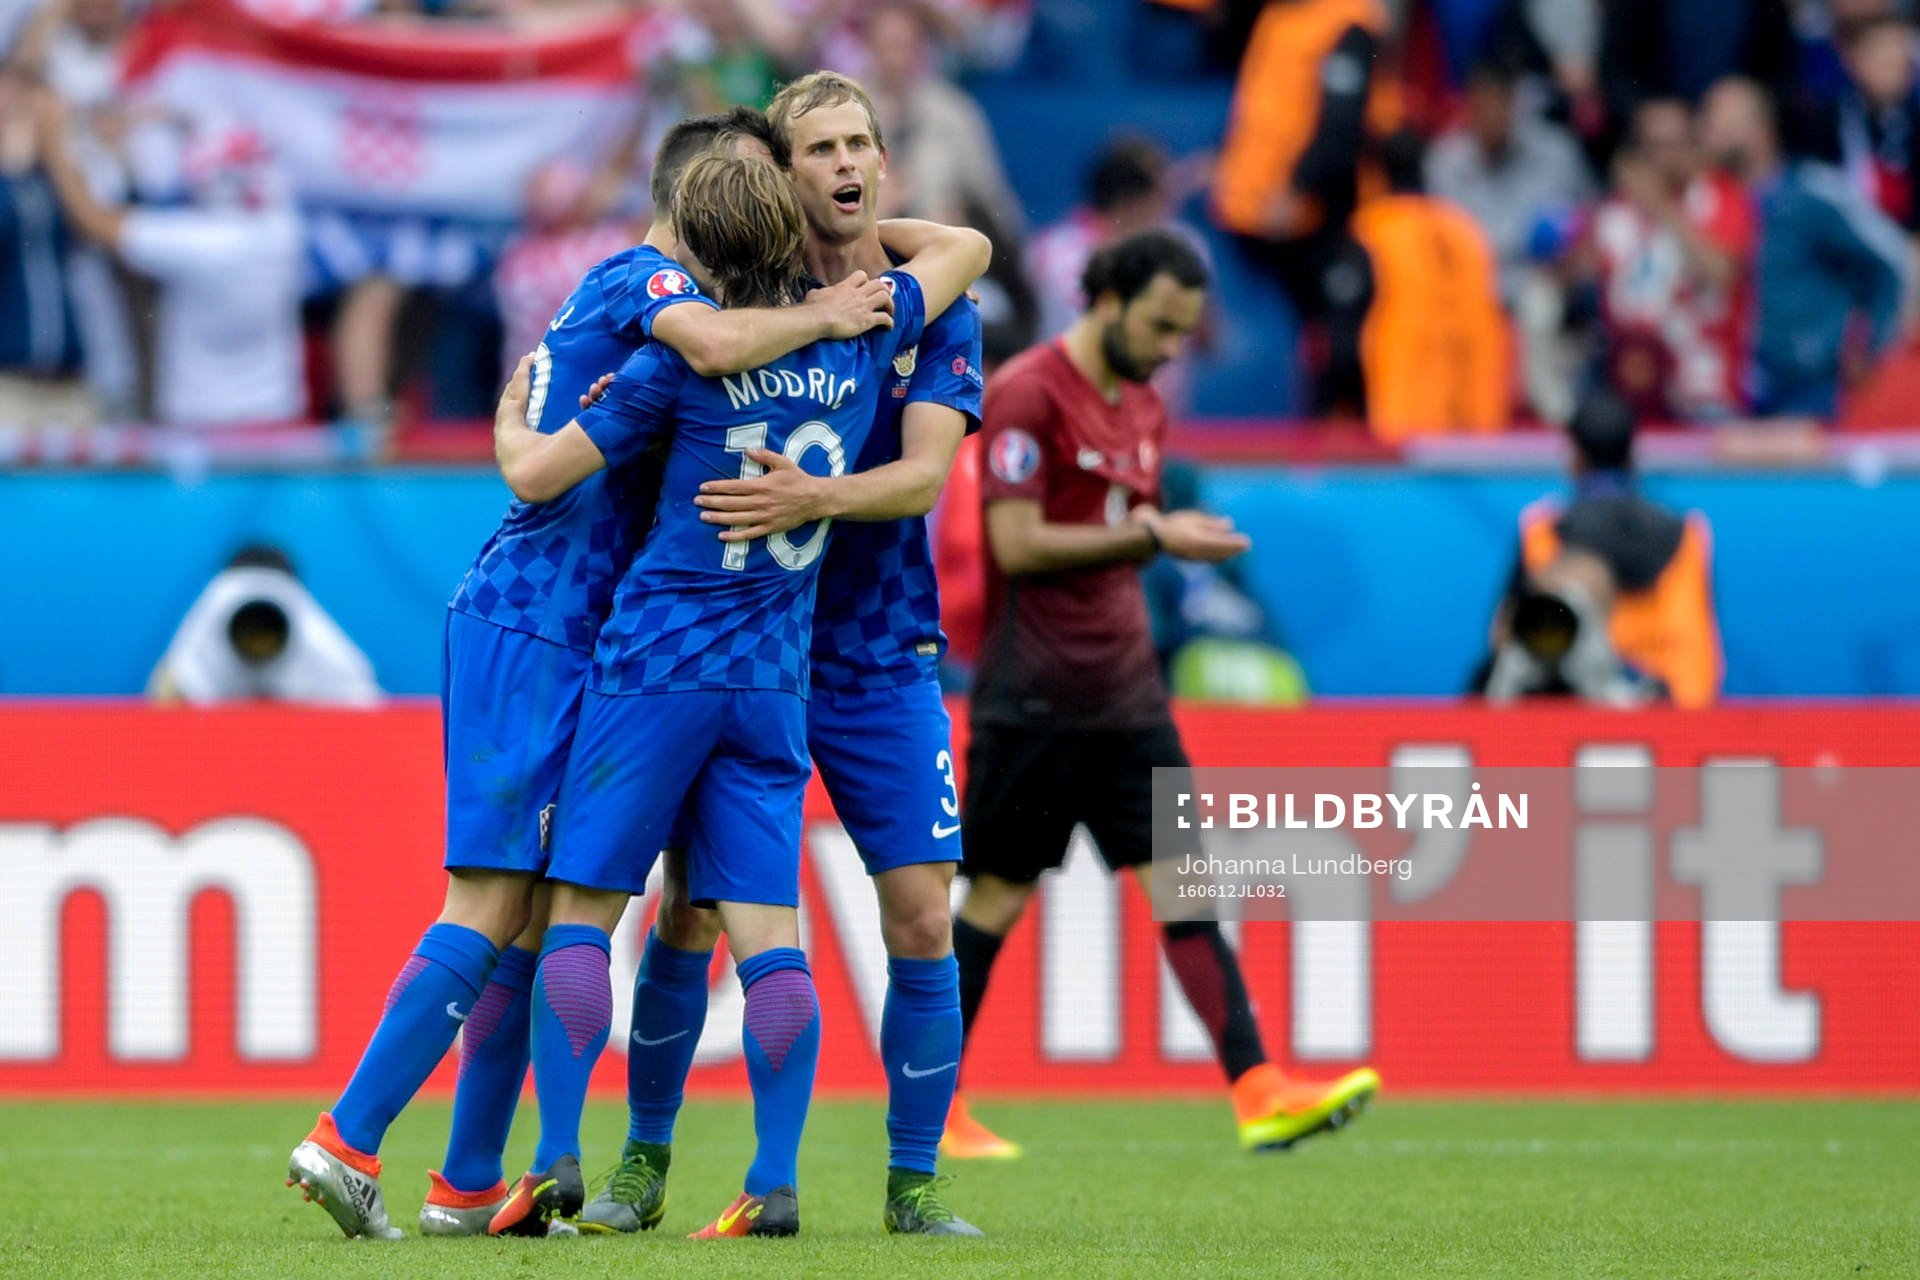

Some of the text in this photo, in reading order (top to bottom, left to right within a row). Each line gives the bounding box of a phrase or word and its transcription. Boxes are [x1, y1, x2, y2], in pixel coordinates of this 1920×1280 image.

[721, 420, 847, 571] 10
[936, 749, 960, 818] 3
[1574, 743, 1823, 1063] it
[343, 1174, 370, 1225] adidas
